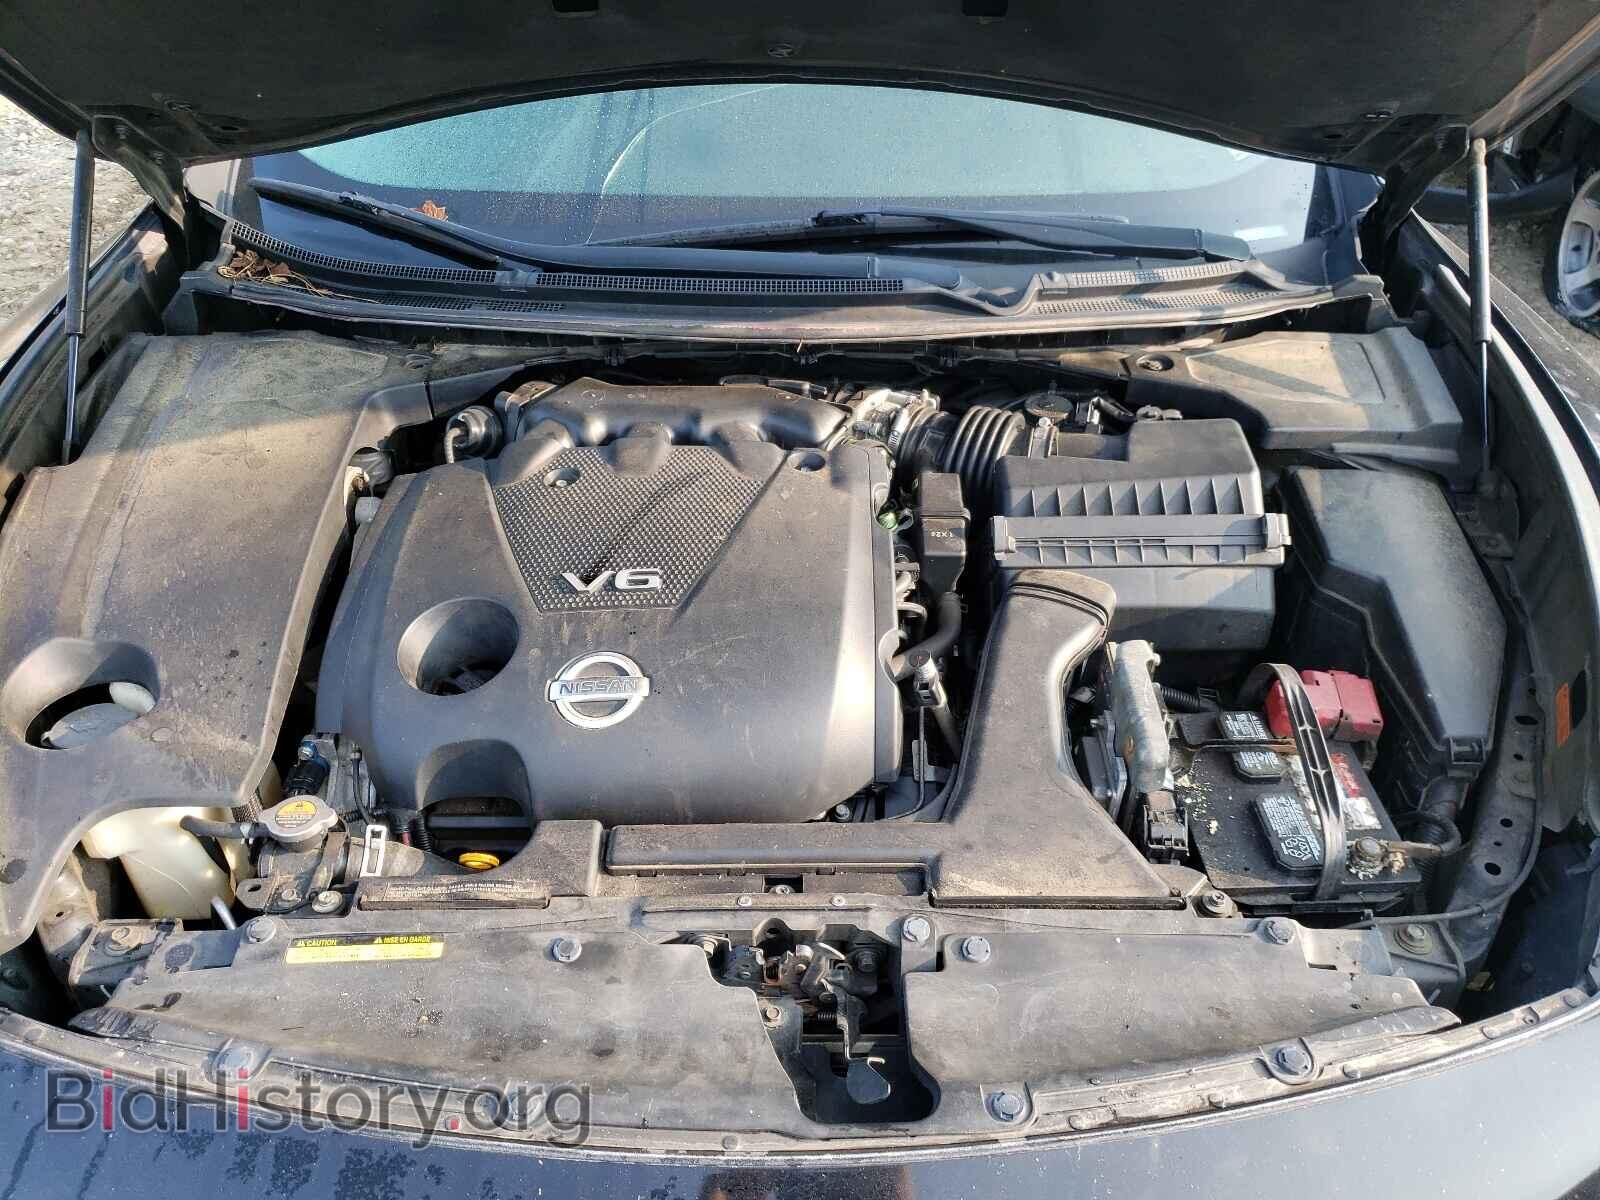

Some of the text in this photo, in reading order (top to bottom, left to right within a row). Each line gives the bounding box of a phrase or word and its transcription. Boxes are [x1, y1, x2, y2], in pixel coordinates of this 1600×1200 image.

[561, 568, 663, 593] V6
[559, 679, 637, 695] NISSAN
[306, 939, 337, 947] CAUTION
